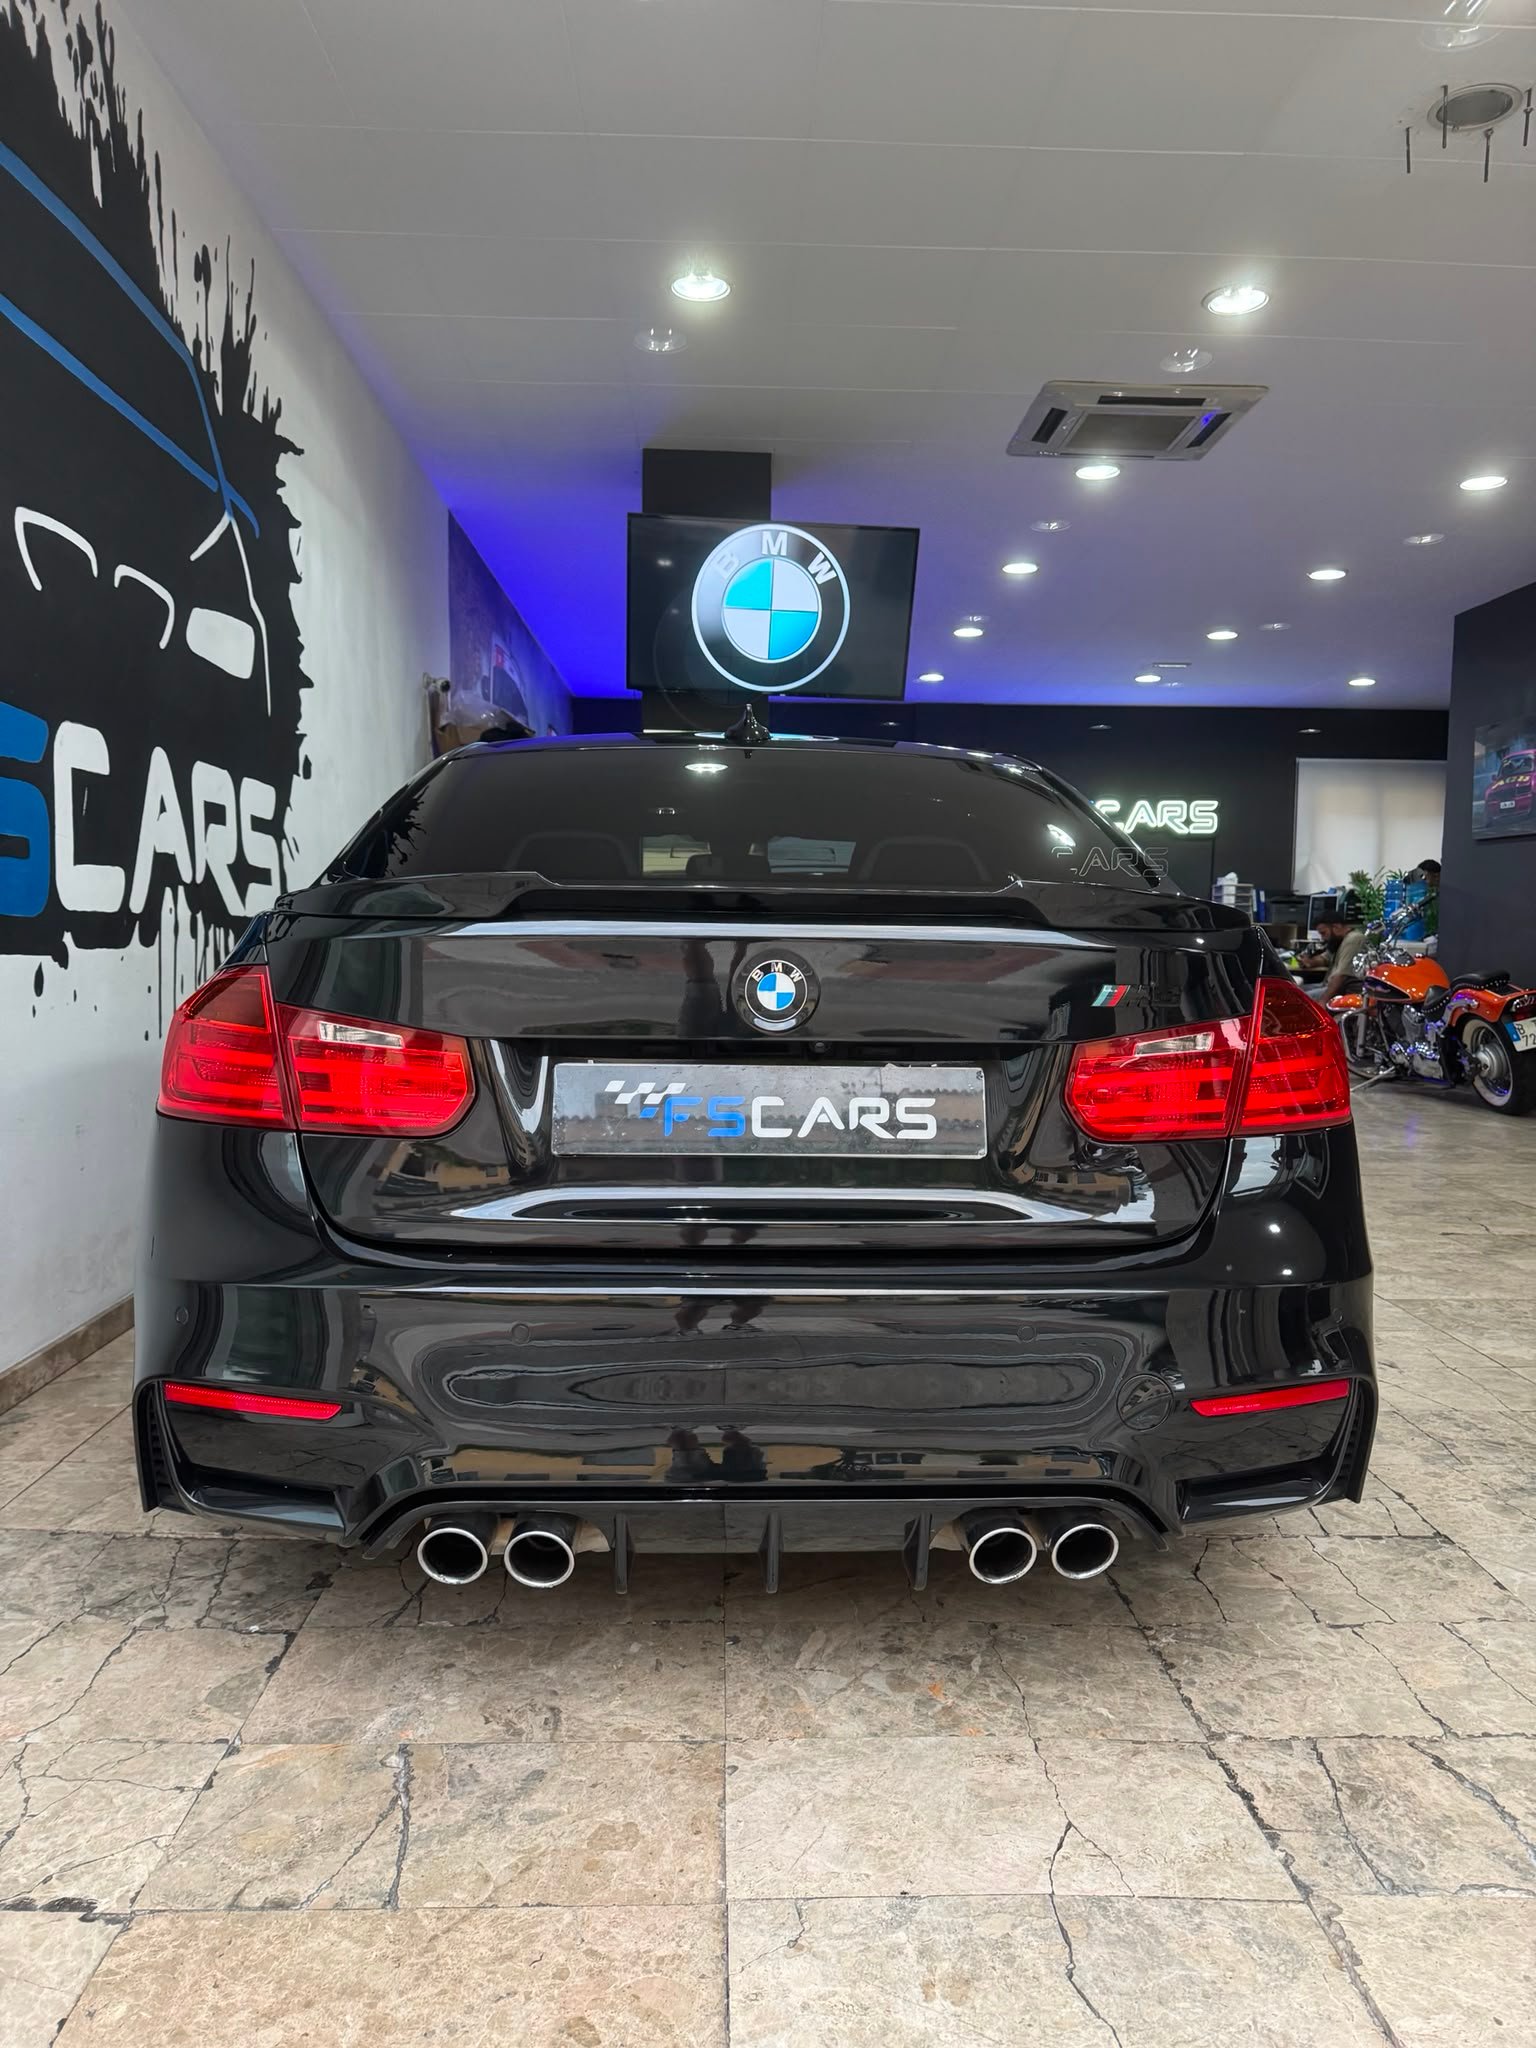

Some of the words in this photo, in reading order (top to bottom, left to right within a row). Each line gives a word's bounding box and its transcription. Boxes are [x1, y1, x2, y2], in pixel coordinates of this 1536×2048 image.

[711, 530, 837, 585] BMW
[751, 962, 803, 983] BMW
[663, 1096, 938, 1140] FSCARS
